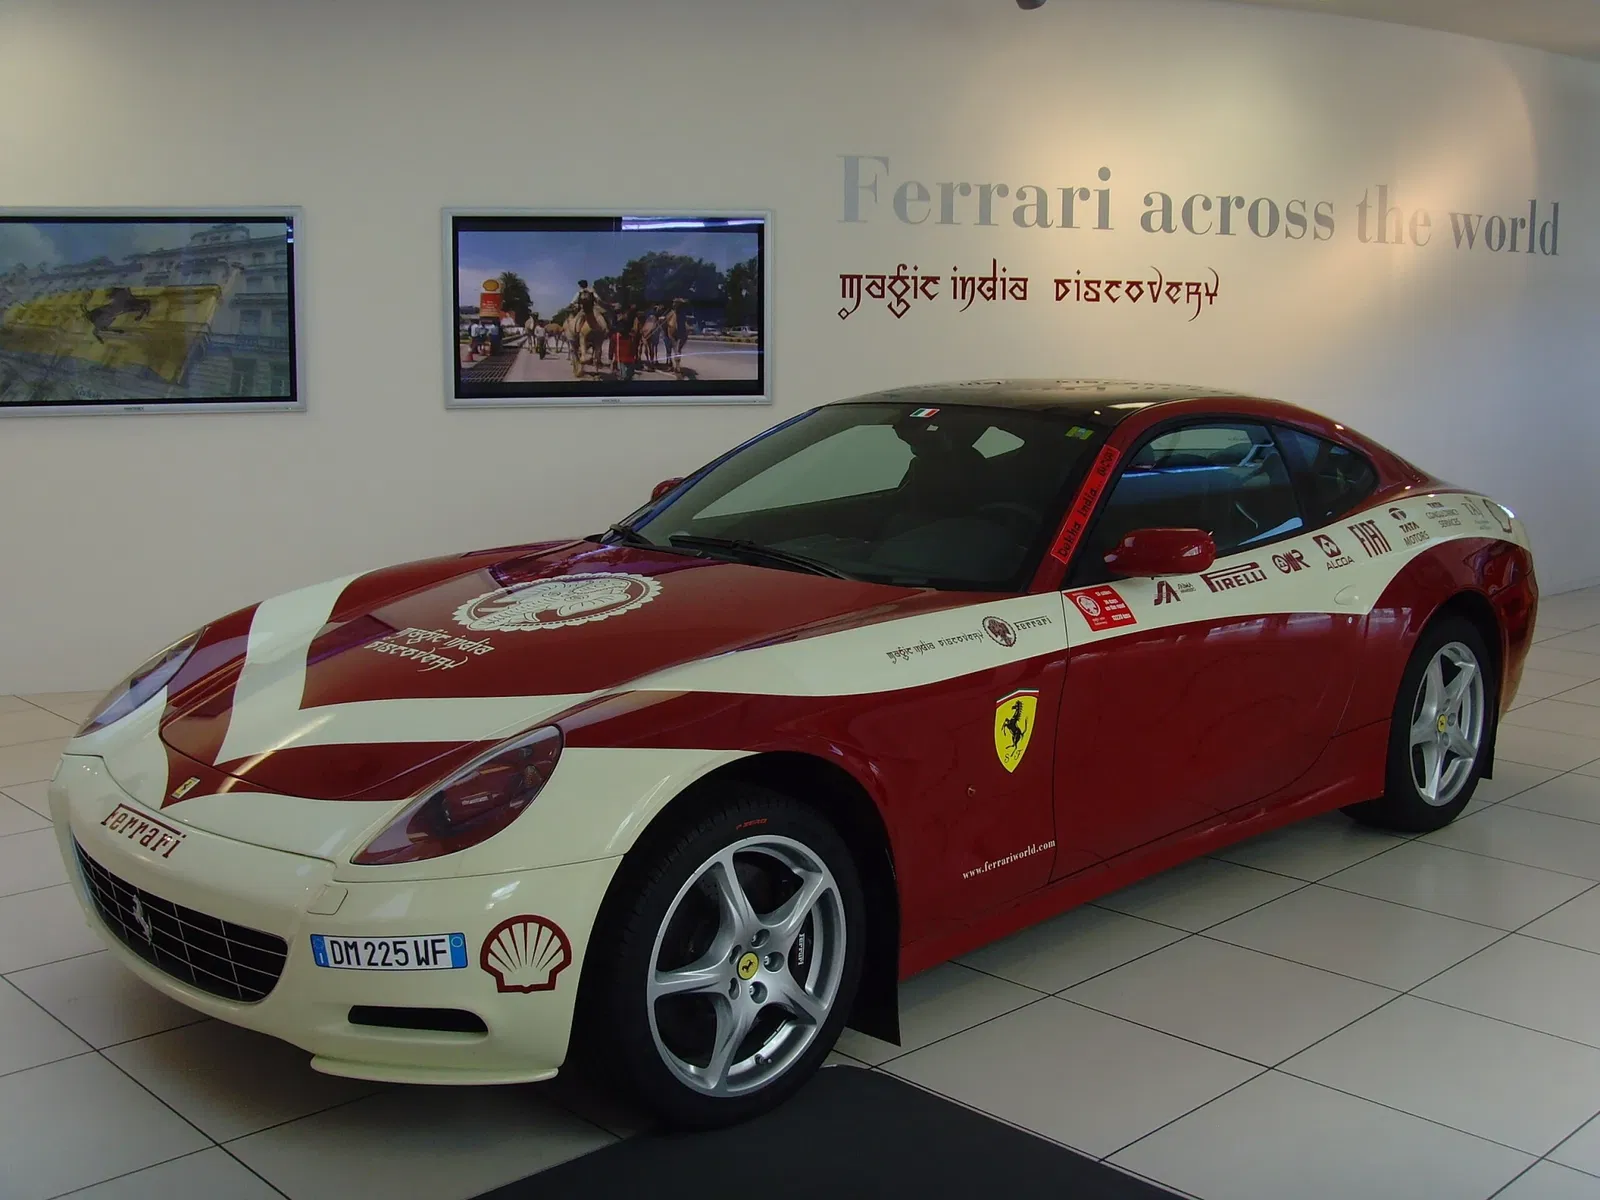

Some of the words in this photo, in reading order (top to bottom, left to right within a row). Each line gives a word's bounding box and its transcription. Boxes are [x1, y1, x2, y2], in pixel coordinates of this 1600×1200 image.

[837, 155, 1114, 230] Ferrari
[1140, 190, 1335, 241] across
[1355, 184, 1432, 247] the
[1448, 198, 1560, 256] world
[1347, 519, 1392, 558] FIAT
[1399, 521, 1420, 534] TATA
[1403, 530, 1430, 547] MOTORS
[1199, 561, 1268, 593] PIRELLI
[1326, 555, 1356, 571] ALCOA
[1013, 615, 1053, 631] Ferrari
[100, 802, 187, 859] Ferrari
[962, 838, 1056, 880] www.ferrariworld.com
[330, 939, 362, 966] DM
[363, 939, 410, 967] 225
[413, 938, 449, 967] WF
